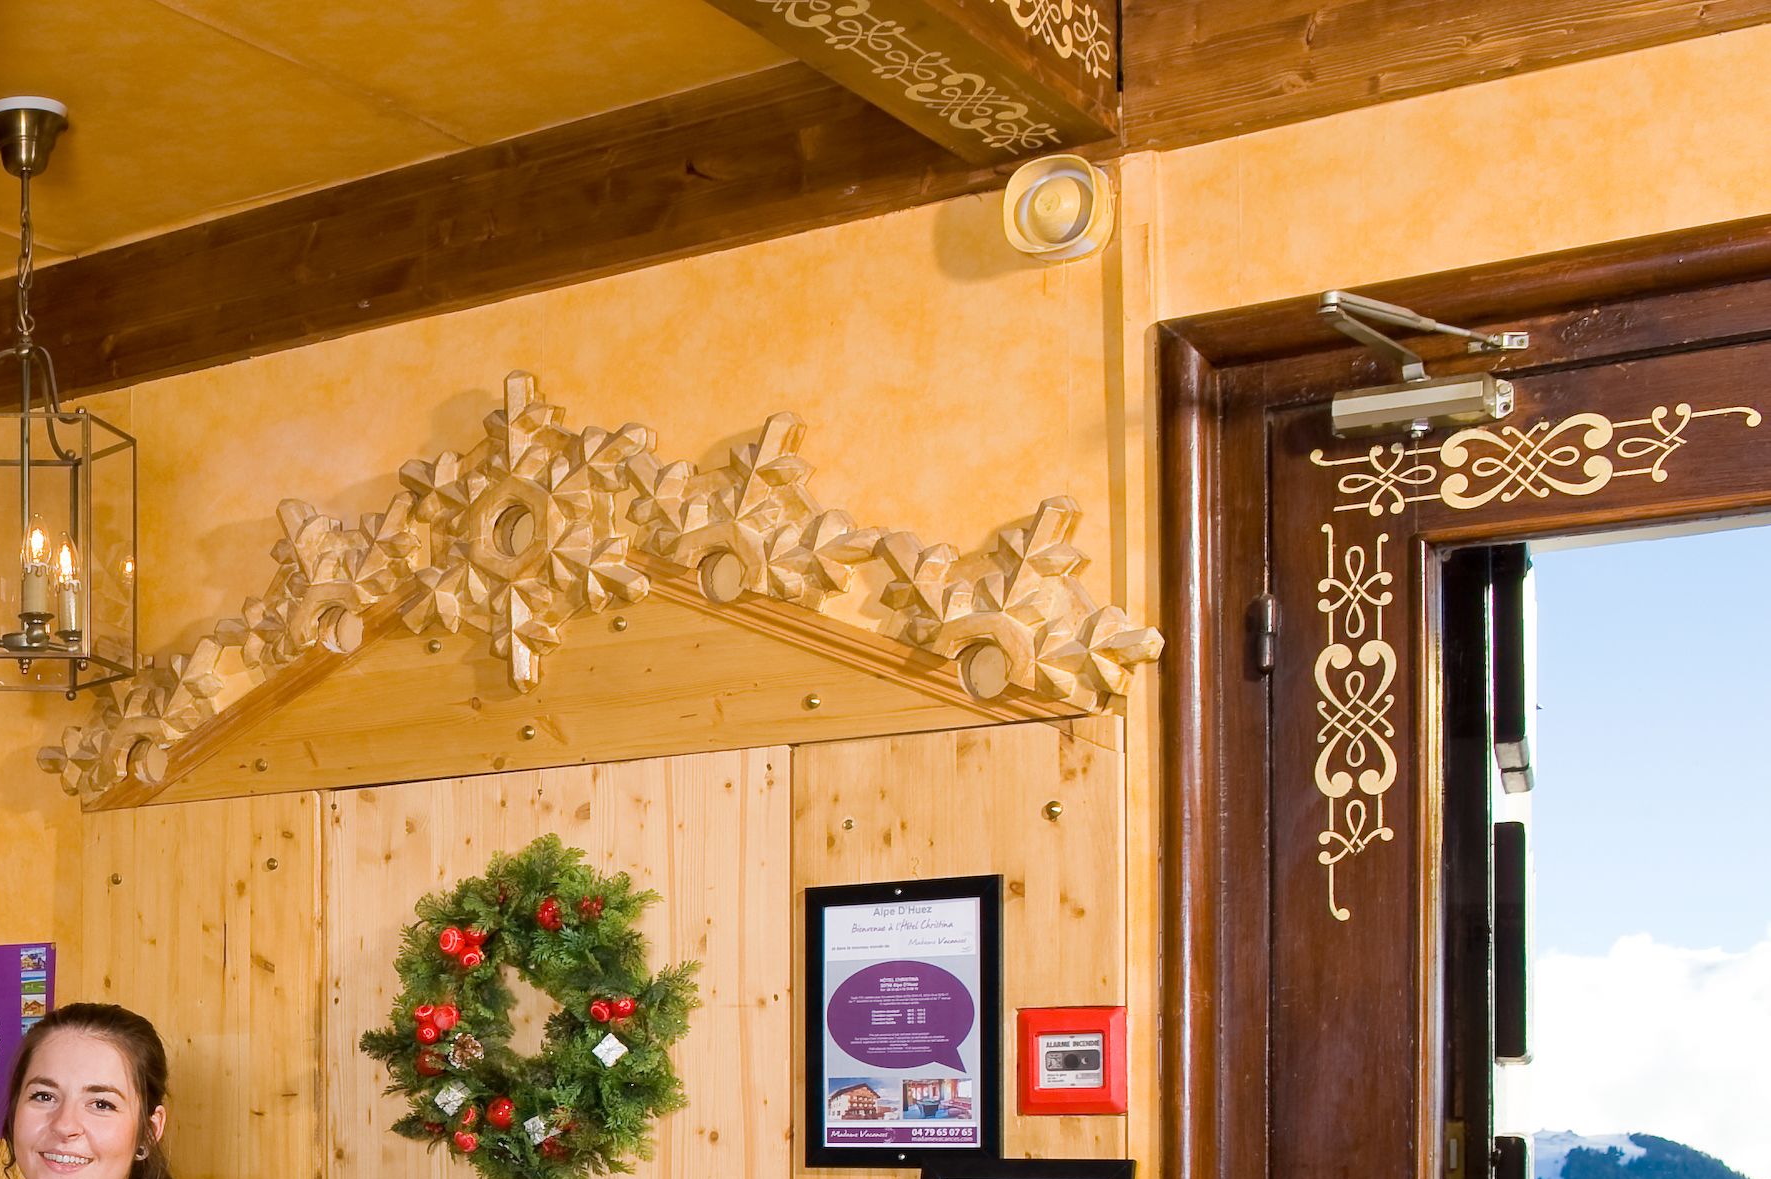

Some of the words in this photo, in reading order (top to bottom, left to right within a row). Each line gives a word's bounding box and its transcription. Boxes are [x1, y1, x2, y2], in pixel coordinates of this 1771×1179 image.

[872, 907, 896, 918] Alpe
[851, 922, 886, 934] Bienvenue
[920, 918, 954, 930] Christina
[830, 1129, 859, 1138] Madame
[859, 1129, 888, 1138] Vacances
[911, 1127, 922, 1136] 04
[924, 1127, 935, 1136] 79
[936, 1127, 948, 1136] 65
[949, 1127, 960, 1136] 07
[961, 1127, 973, 1136] 65
